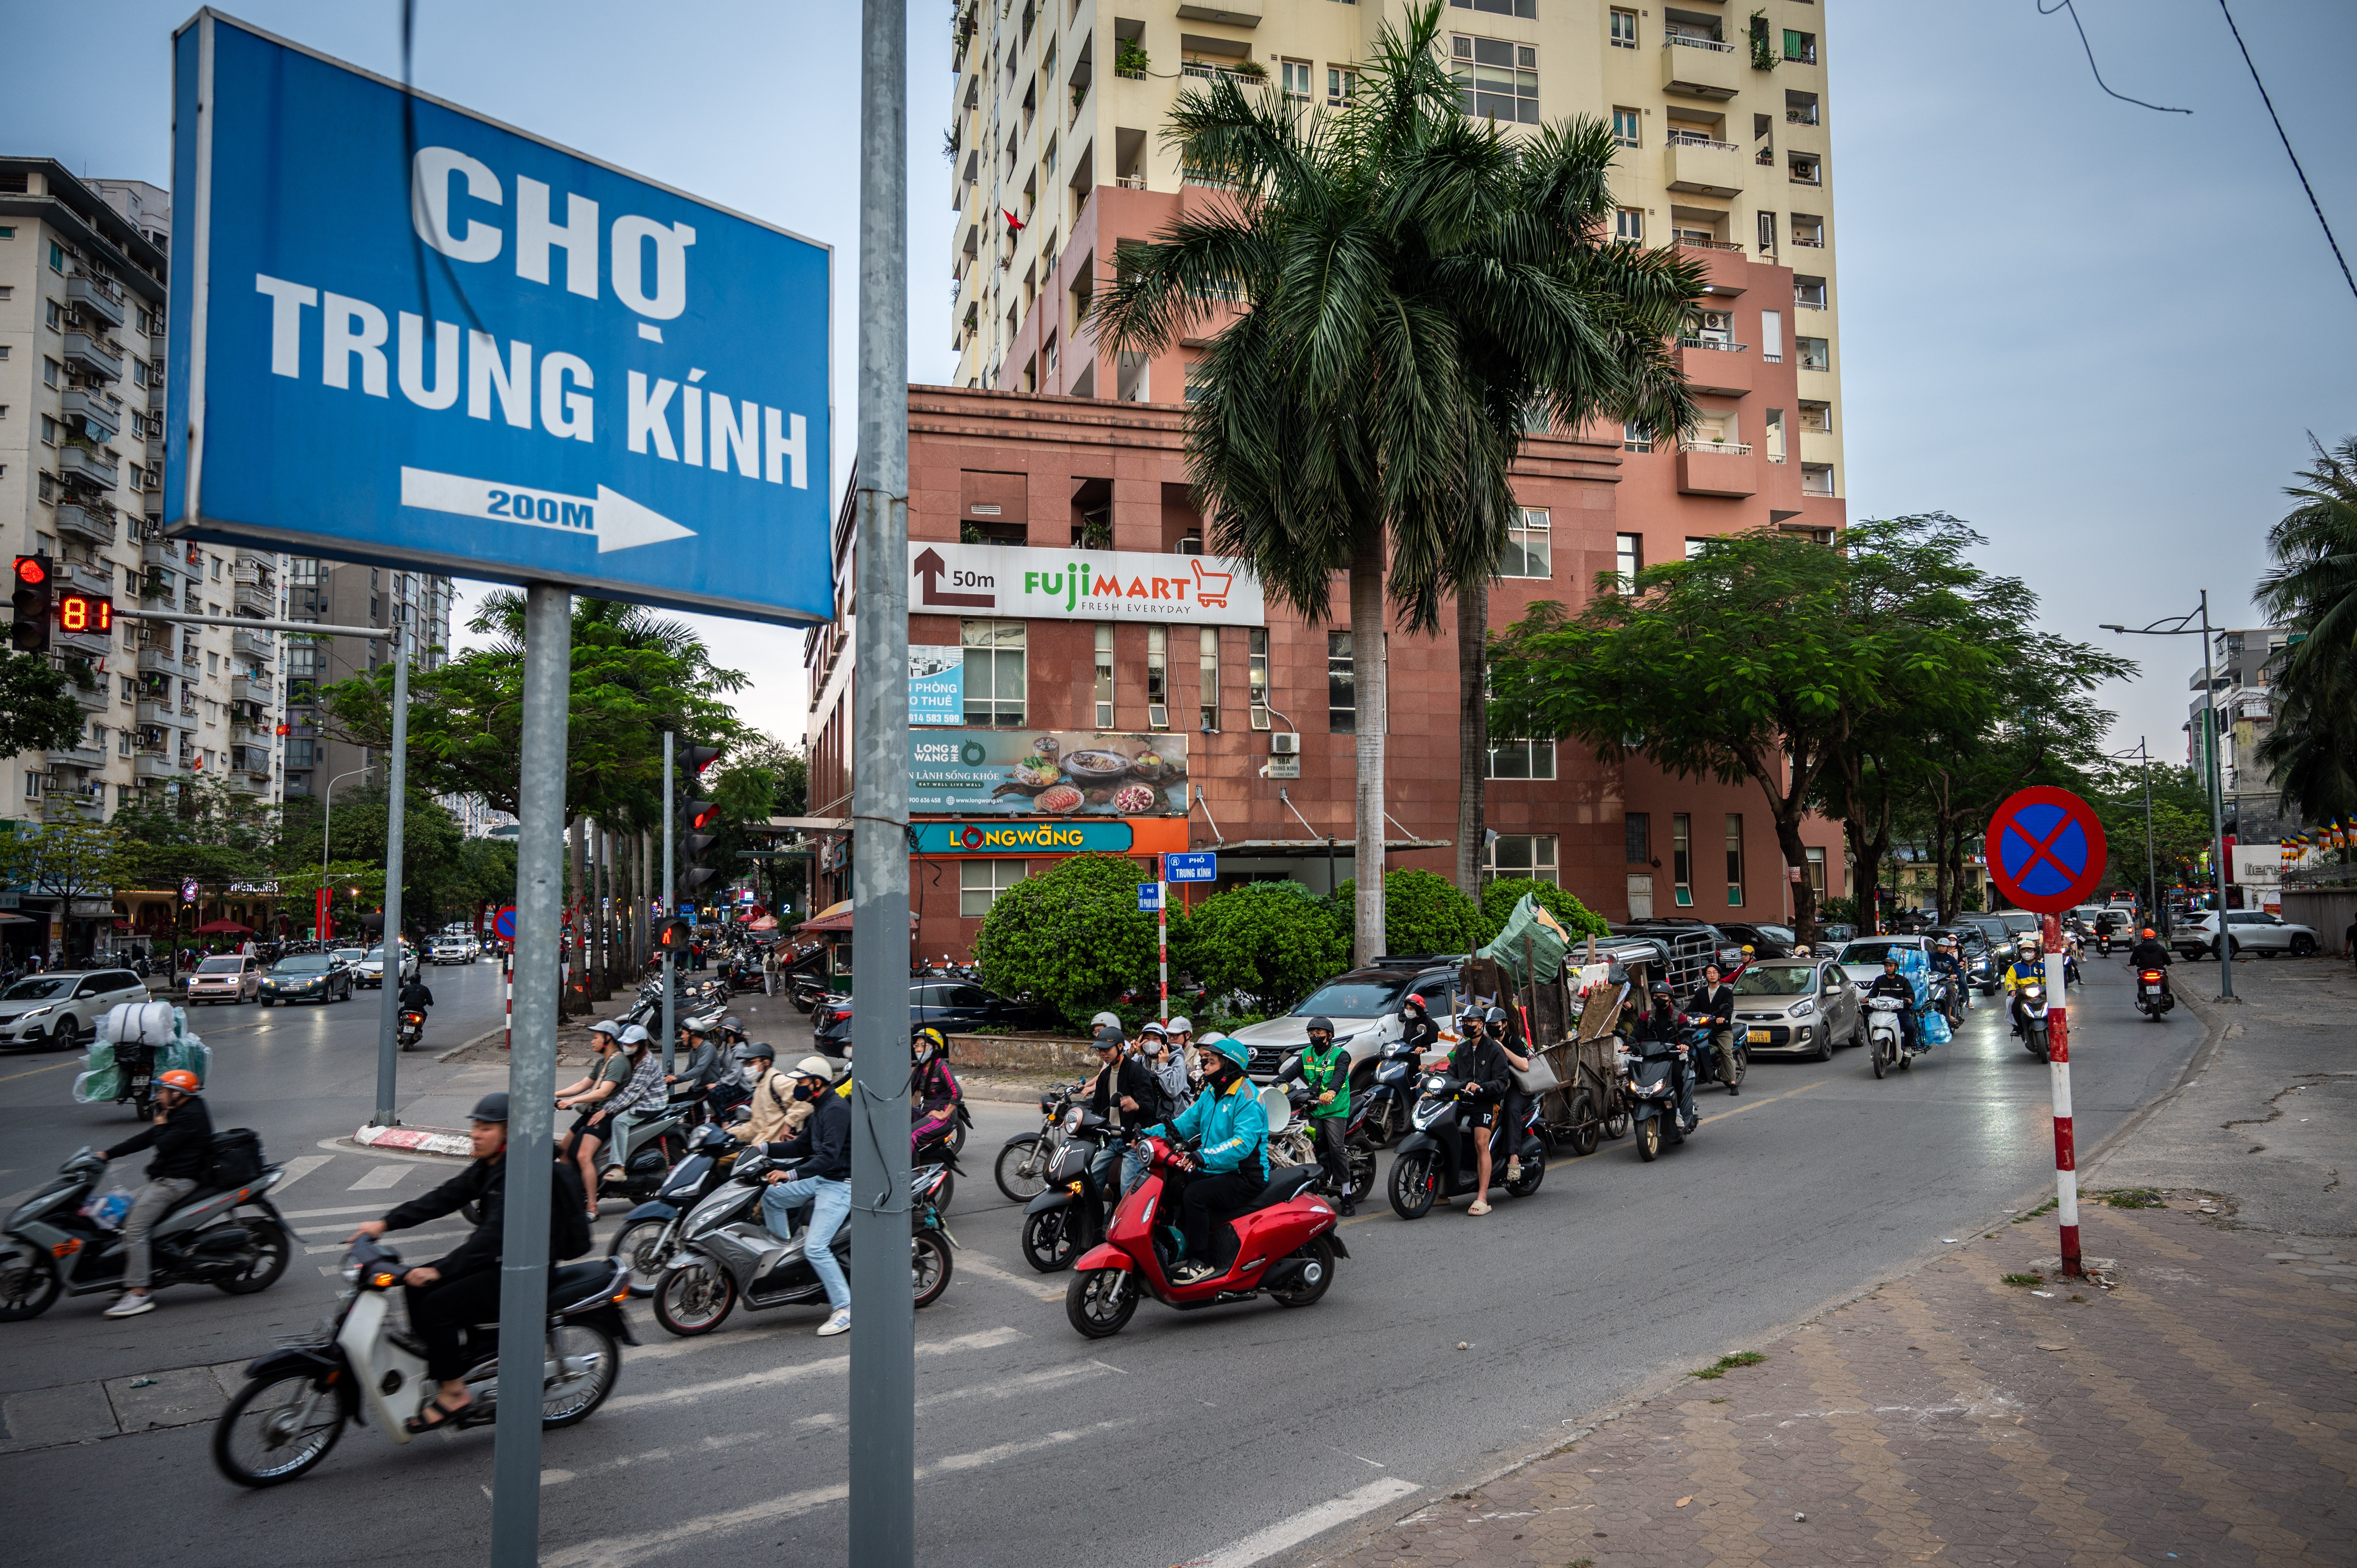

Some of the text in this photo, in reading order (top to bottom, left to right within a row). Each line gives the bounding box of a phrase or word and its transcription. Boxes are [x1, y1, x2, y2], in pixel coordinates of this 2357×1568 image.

[412, 146, 696, 344] CHỢ
[256, 273, 807, 490] TRUNG KÍNH
[488, 490, 594, 529] 200M
[953, 571, 994, 587] 50m
[64, 598, 108, 629] 81
[1082, 602, 1191, 614] FRESH EVERYDAY
[916, 682, 957, 693] PHÒNG
[921, 695, 952, 705] THUÊ
[909, 714, 959, 723] 914 583 599
[917, 744, 949, 753] LONG
[914, 753, 949, 762] WANG
[917, 770, 943, 779] LÀNH
[945, 770, 970, 780] SỐNG
[973, 770, 999, 780] KHỎE
[1189, 855, 1205, 863] PHỐ
[1176, 867, 1211, 878] TRUNG KÍNH
[783, 904, 791, 913] 2
[1483, 1113, 1491, 1124] 17
